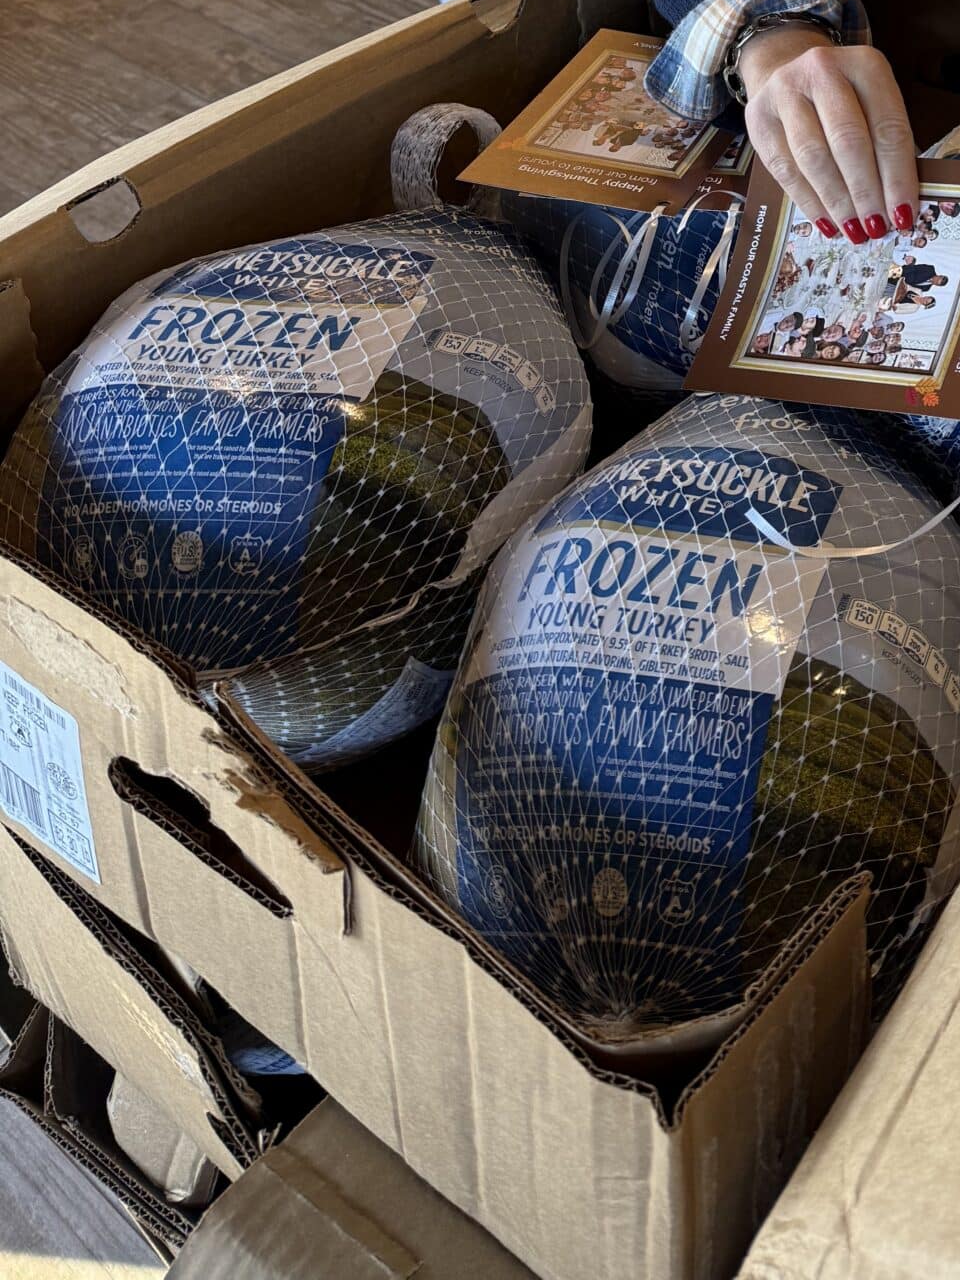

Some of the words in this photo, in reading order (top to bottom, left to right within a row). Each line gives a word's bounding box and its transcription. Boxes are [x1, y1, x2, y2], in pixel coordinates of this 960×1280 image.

[517, 164, 601, 187] Thanksgiving
[558, 162, 571, 170] to
[573, 165, 606, 177] table
[608, 171, 628, 180] our
[628, 174, 658, 186] from
[602, 177, 645, 194] Happy
[754, 204, 768, 234] FROM
[745, 233, 761, 262] YOUR
[732, 262, 754, 307] COASTAL
[128, 304, 362, 352] FROZEN
[718, 307, 738, 342] FAMILY
[137, 343, 213, 366] YOUNG
[220, 348, 315, 371] TURKEY
[81, 500, 121, 516] ADDED
[123, 498, 192, 513] HORMONES
[195, 500, 213, 513] OR
[619, 484, 718, 515] WHITE
[520, 534, 765, 621] FROZEN
[527, 601, 602, 631] YOUNG
[614, 606, 718, 645] TURKEY
[854, 608, 875, 626] 150
[634, 641, 648, 652] OF
[724, 653, 750, 670] SALT,
[677, 663, 727, 684] INCLUDED.
[667, 685, 754, 718] INDEPENDENT
[666, 712, 748, 761] FARMERS
[531, 825, 611, 846] HORMONES
[614, 829, 636, 846] OR
